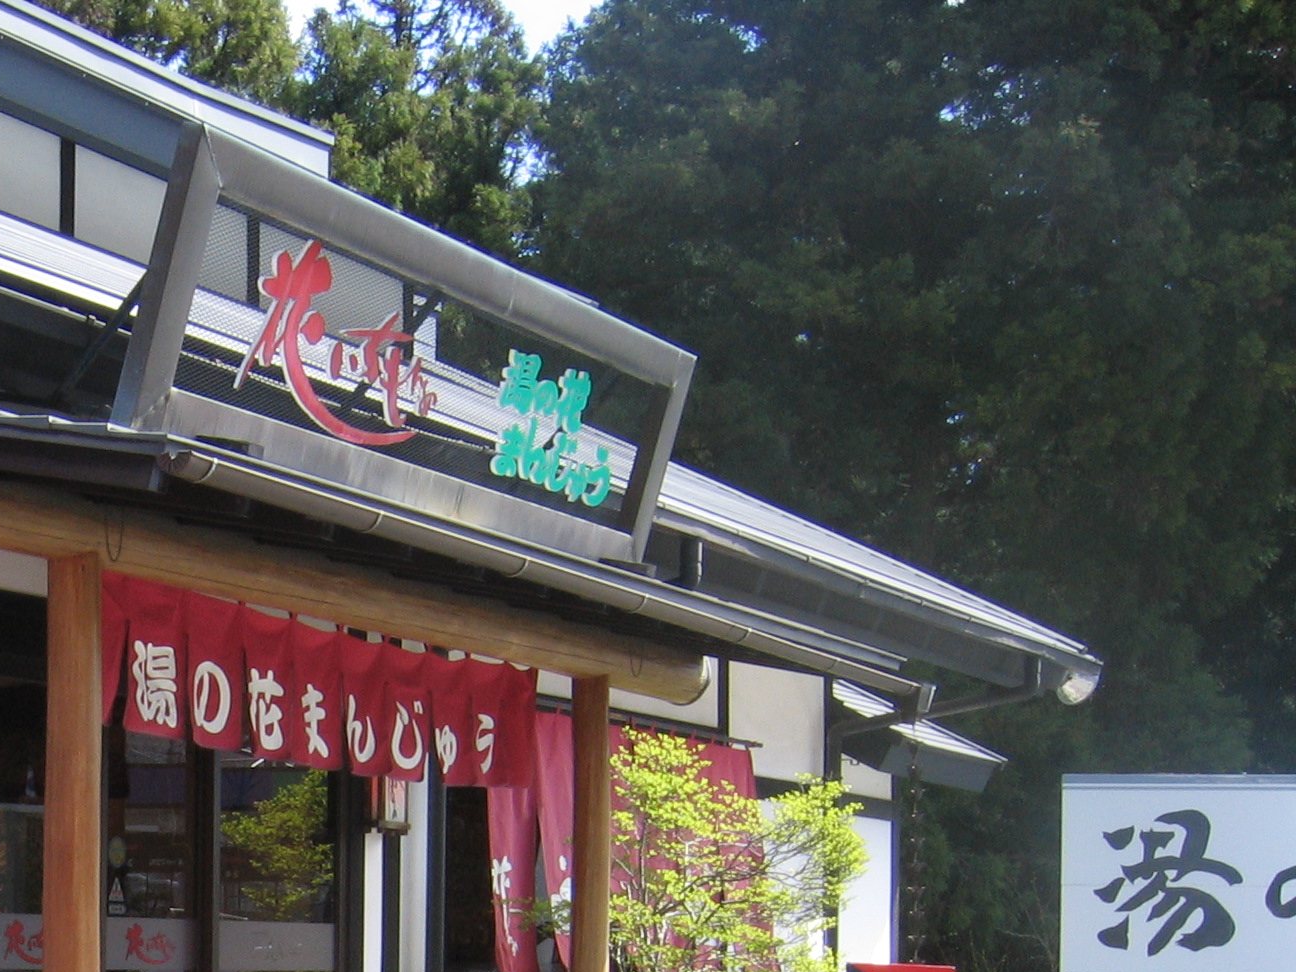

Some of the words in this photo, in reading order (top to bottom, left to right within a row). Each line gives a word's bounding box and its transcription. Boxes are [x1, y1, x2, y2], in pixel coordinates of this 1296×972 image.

[497, 349, 592, 434] 湯の花
[490, 416, 611, 508] まんじゅう
[133, 640, 497, 776] 湯の花まんじゅう
